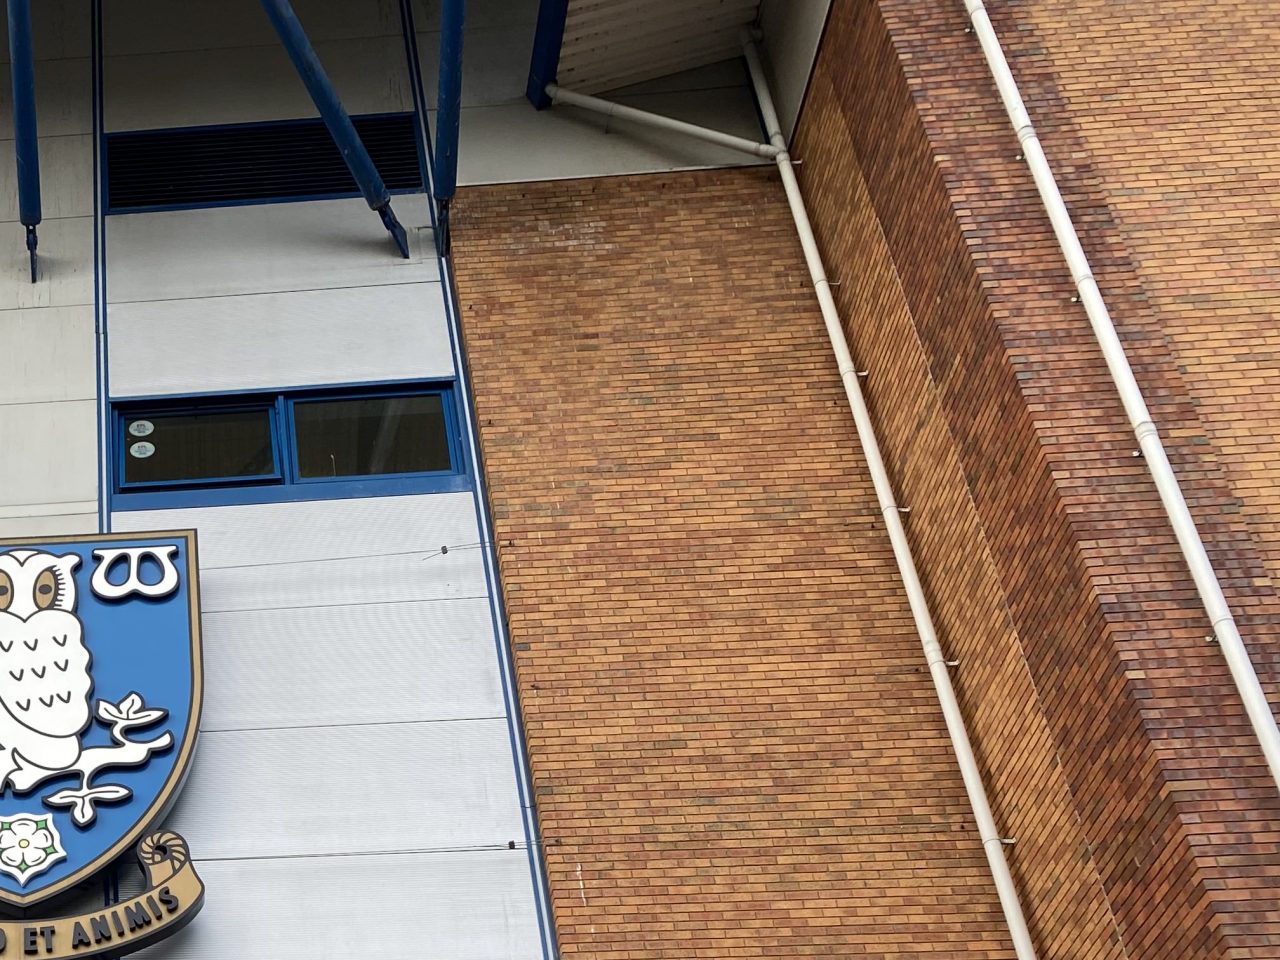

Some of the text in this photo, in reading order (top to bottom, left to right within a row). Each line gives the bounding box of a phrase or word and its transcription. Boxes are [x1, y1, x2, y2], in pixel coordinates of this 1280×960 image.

[90, 545, 180, 605] W
[23, 926, 56, 955] ET
[72, 886, 180, 949] ANIMIS
